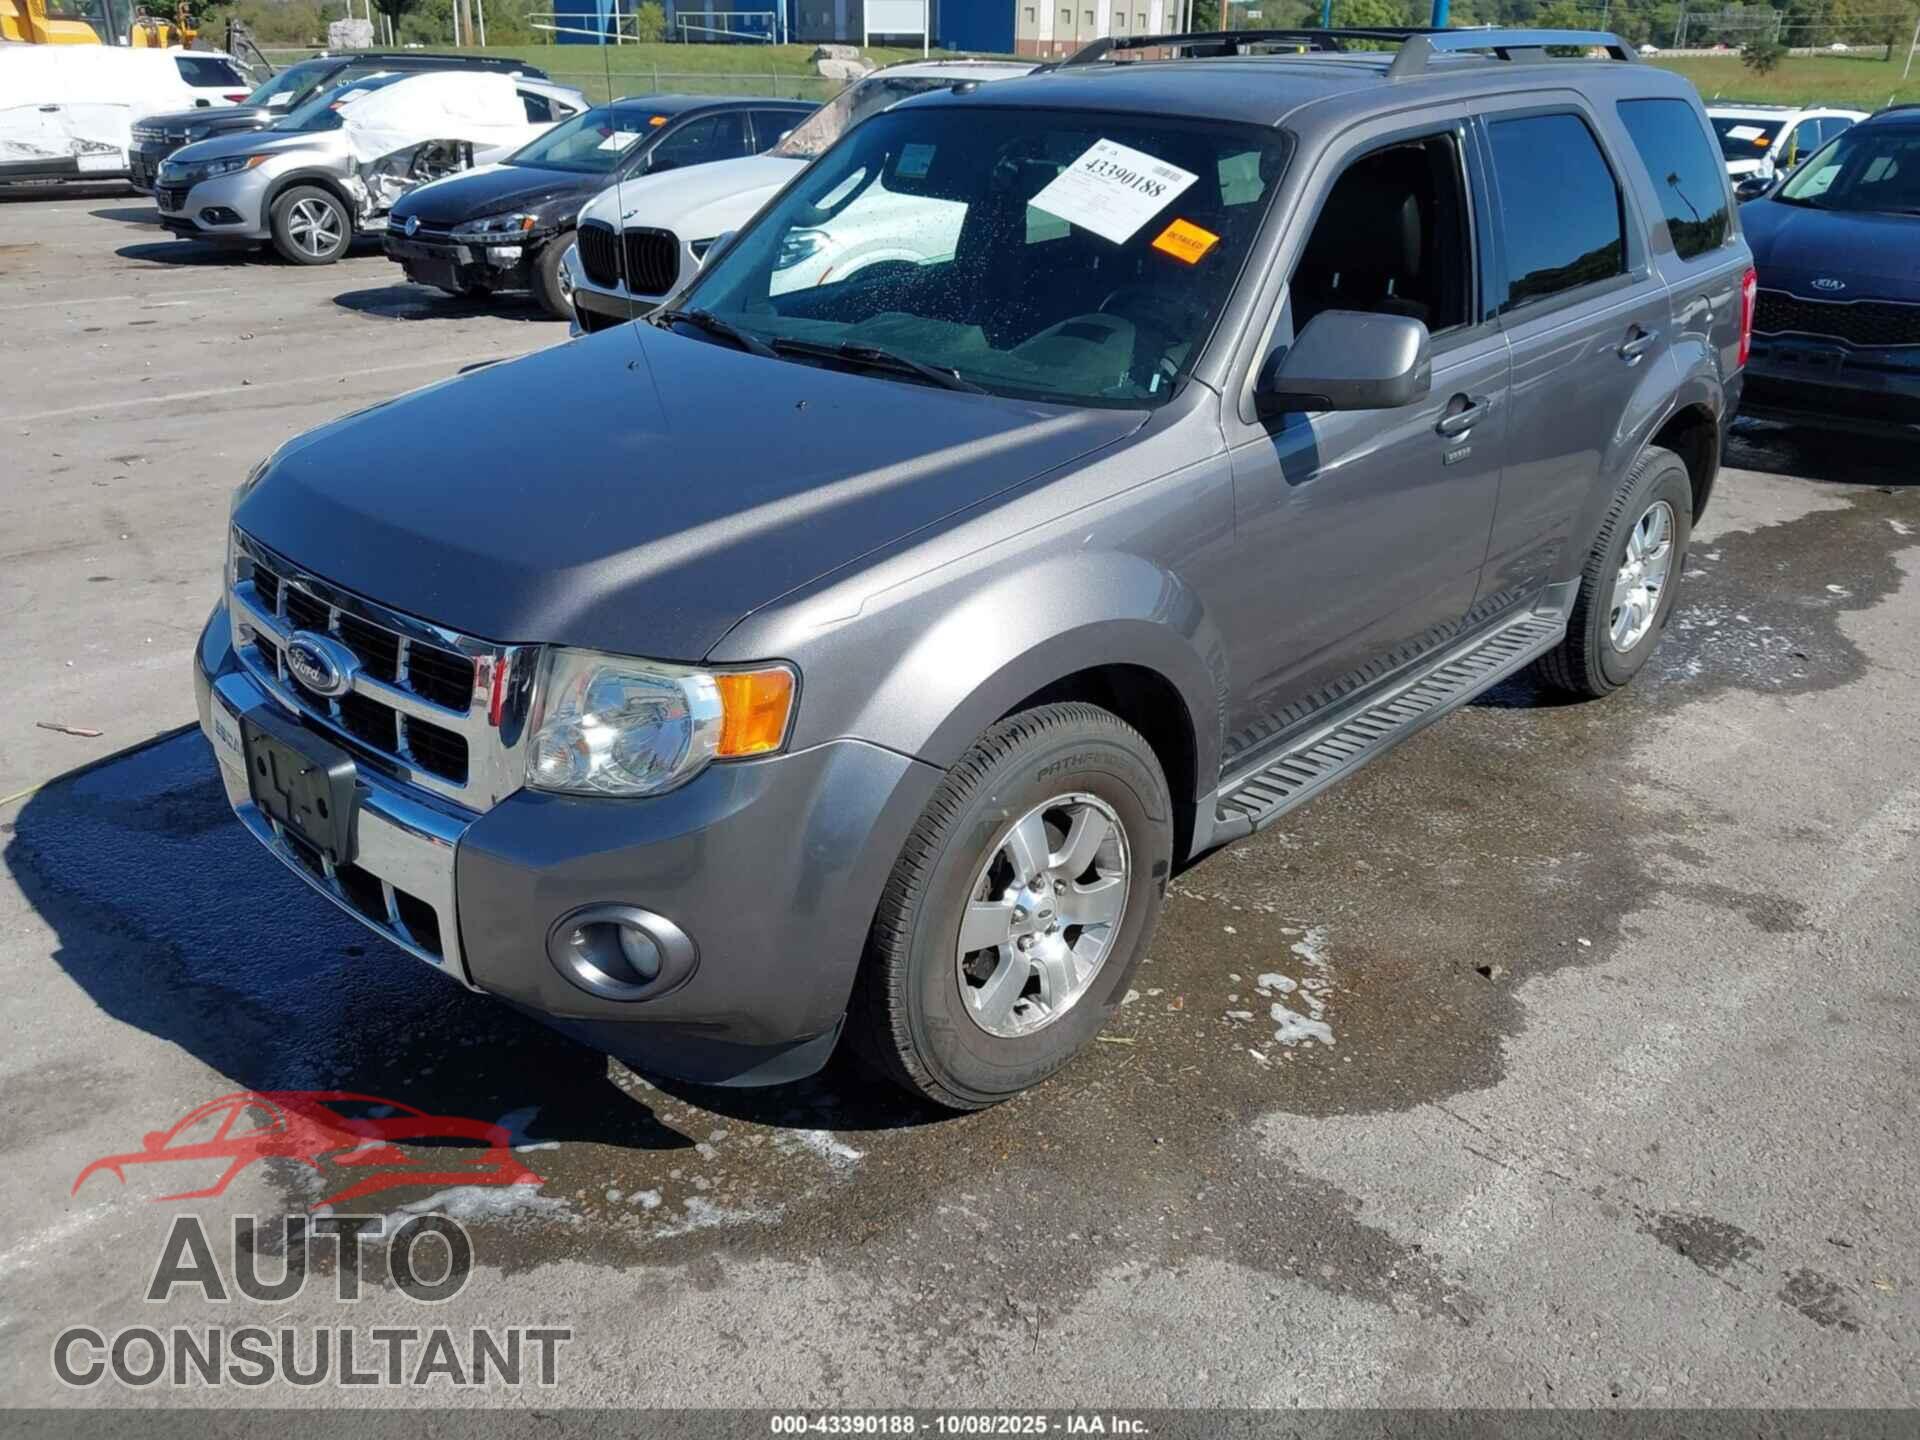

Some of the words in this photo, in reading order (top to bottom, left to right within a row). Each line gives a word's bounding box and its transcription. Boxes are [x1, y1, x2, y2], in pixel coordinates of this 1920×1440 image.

[1085, 159, 1167, 197] 43390188
[1817, 279, 1839, 288] KIA
[292, 648, 321, 682] Ford
